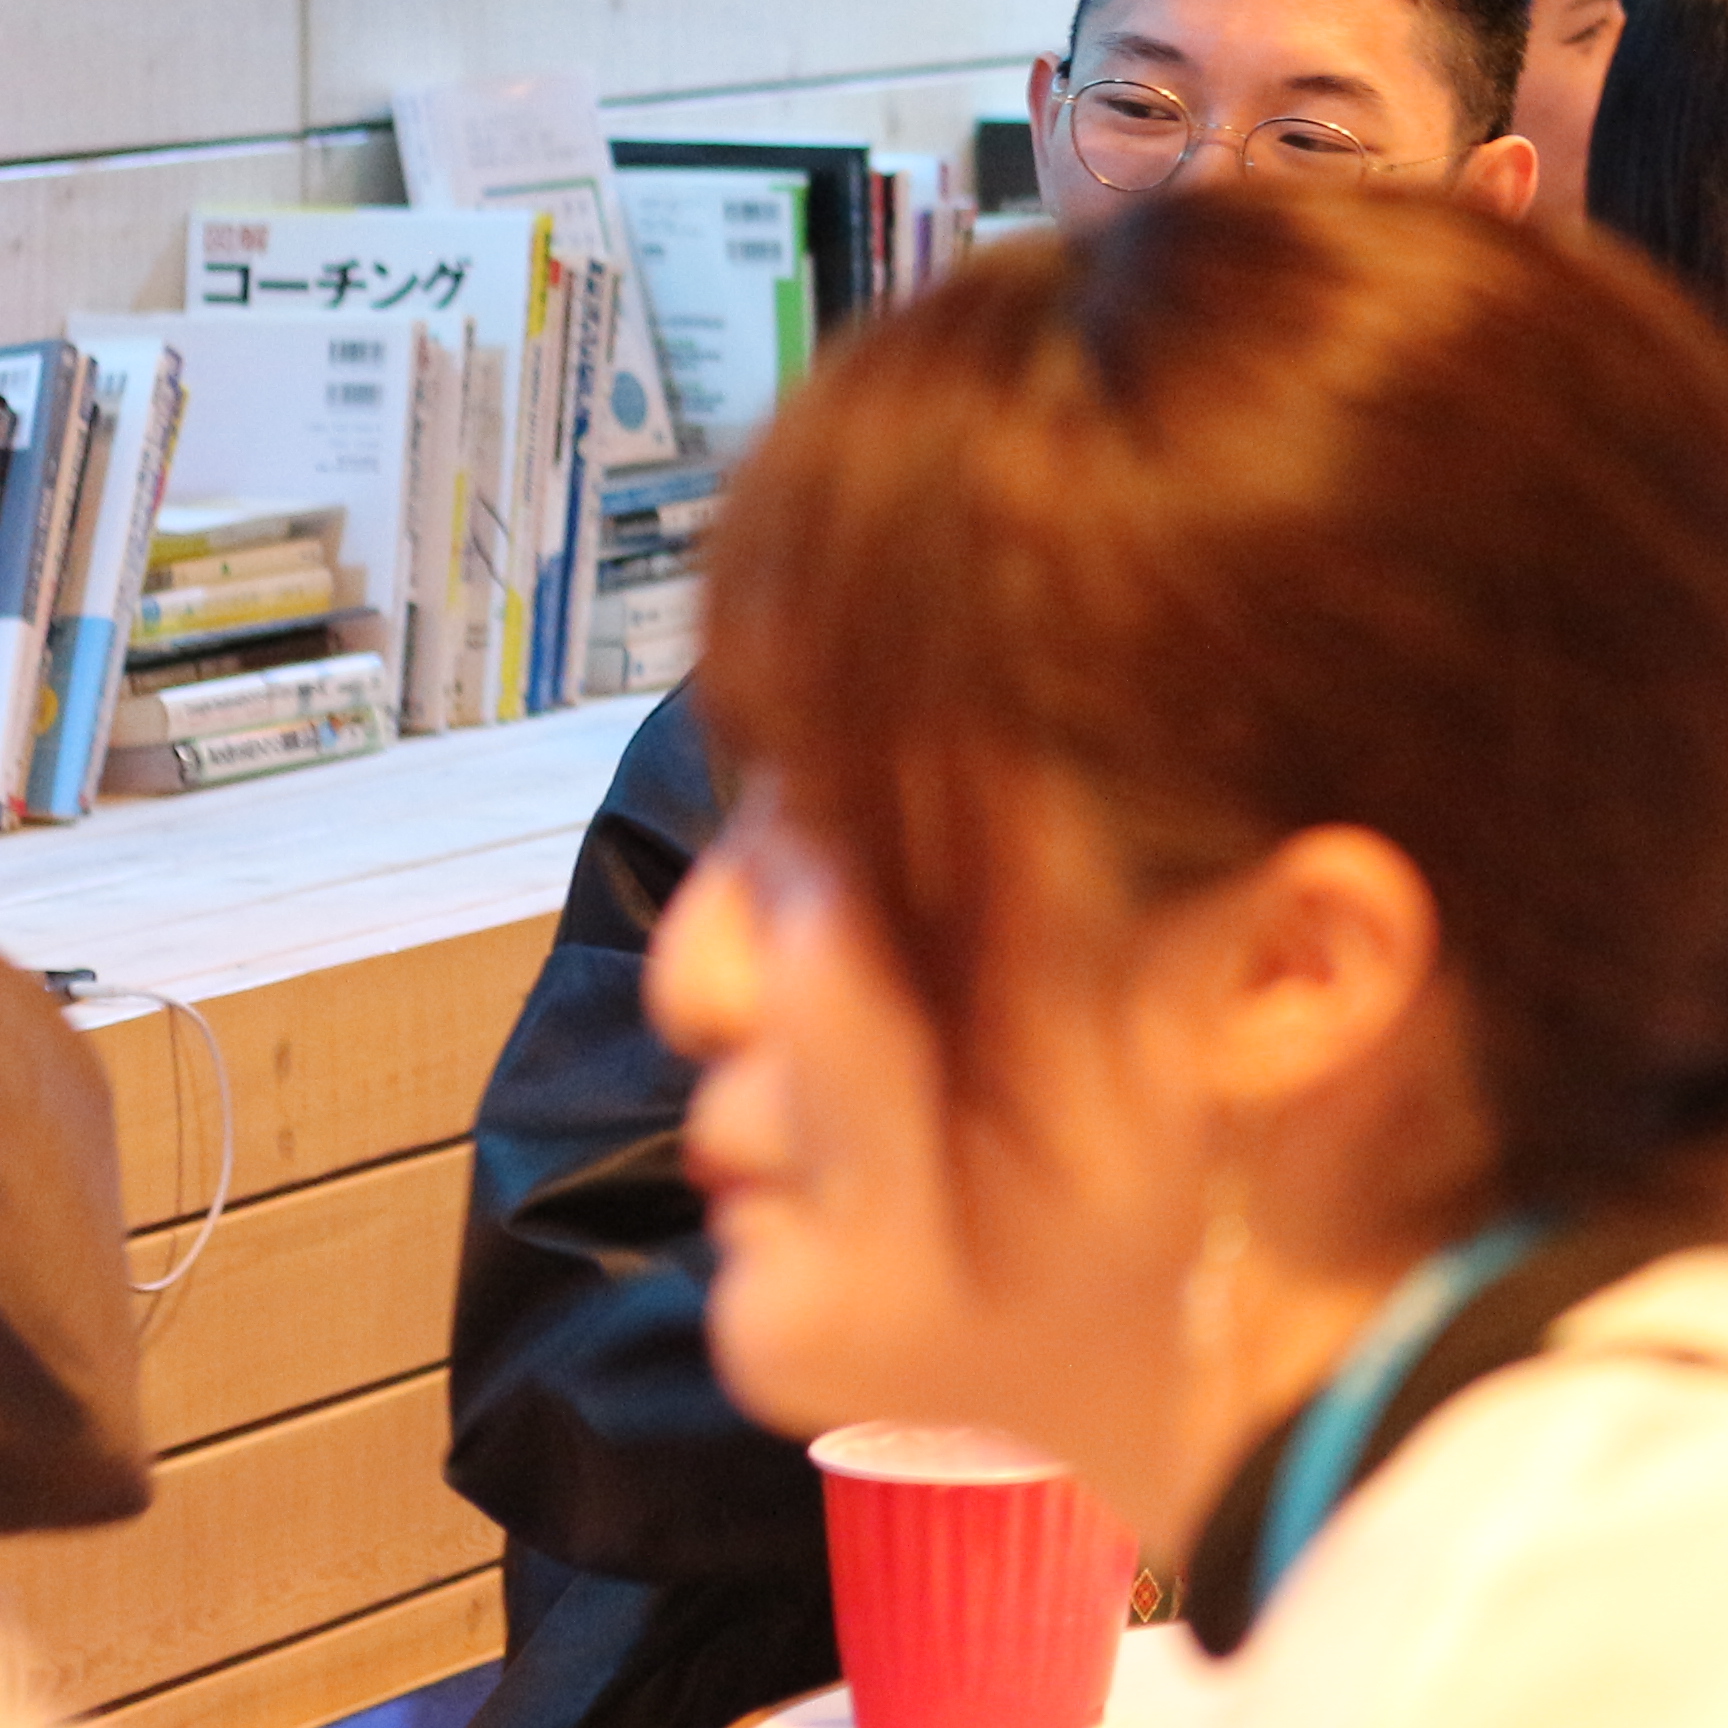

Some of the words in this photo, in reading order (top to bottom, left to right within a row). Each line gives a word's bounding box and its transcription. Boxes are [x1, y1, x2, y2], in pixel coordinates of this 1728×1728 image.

[202, 257, 472, 309] コーチング
